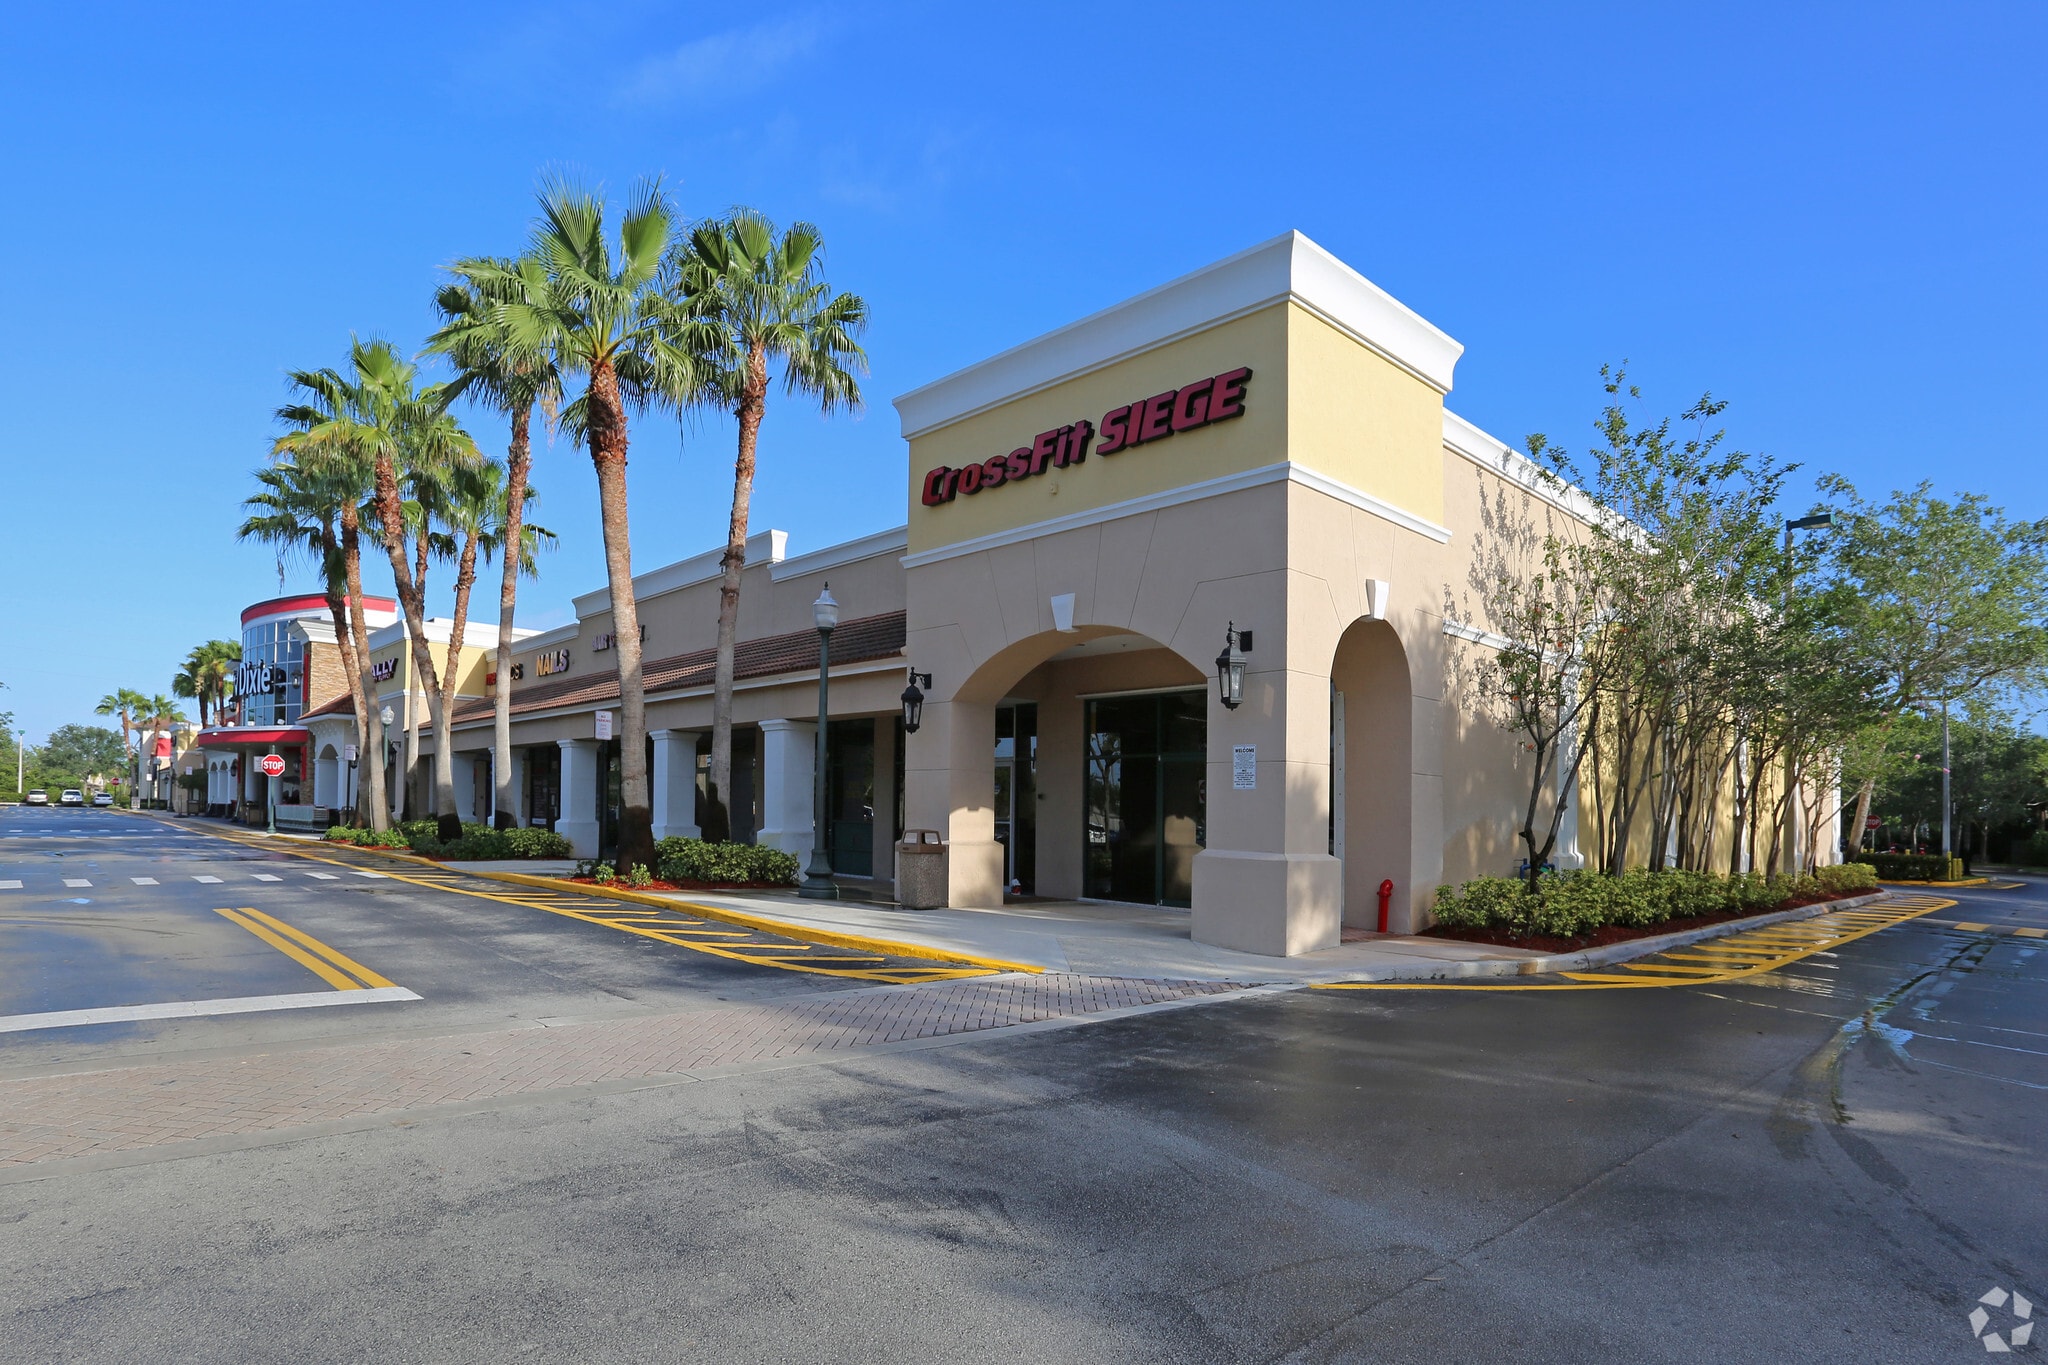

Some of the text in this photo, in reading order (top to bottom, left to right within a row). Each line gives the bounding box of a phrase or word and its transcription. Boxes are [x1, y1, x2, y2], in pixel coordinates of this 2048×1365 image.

[921, 366, 1253, 507] CrossFit SIEGE
[371, 657, 397, 678] ALLY
[536, 648, 569, 677] NAILS
[239, 661, 273, 696] Dixie
[263, 760, 283, 770] STOP
